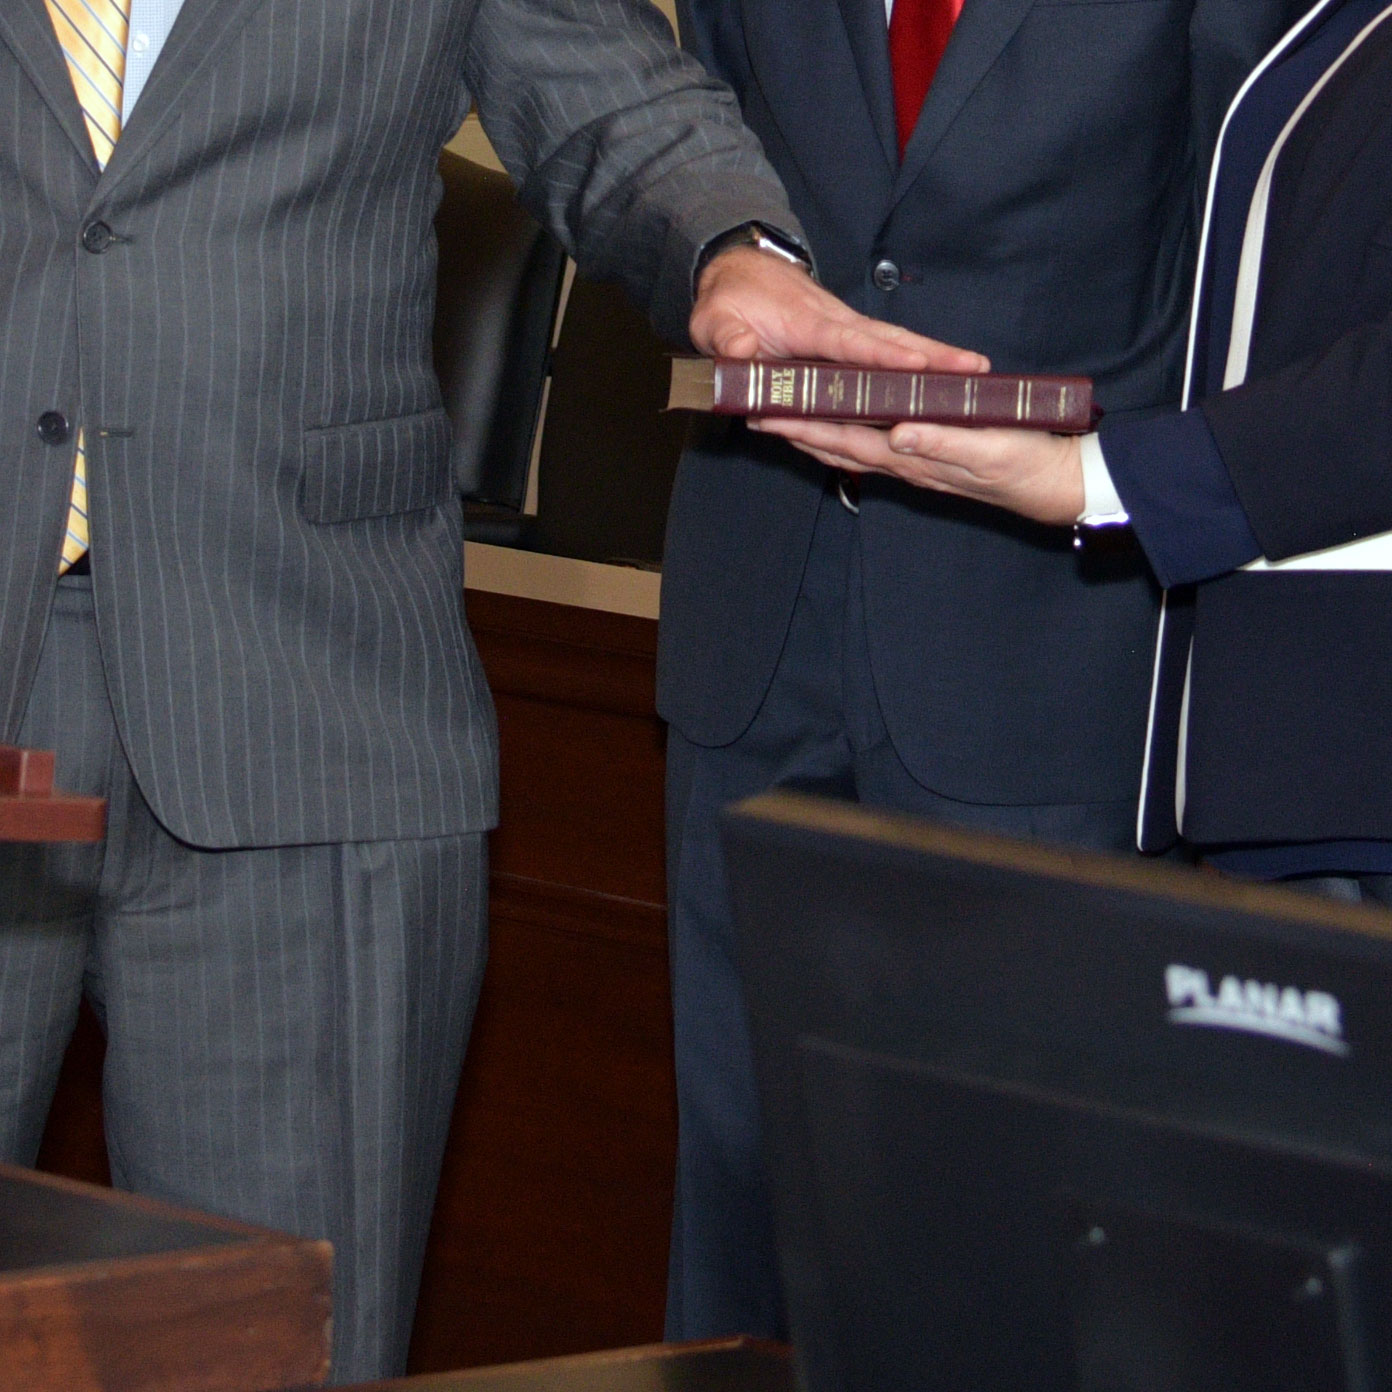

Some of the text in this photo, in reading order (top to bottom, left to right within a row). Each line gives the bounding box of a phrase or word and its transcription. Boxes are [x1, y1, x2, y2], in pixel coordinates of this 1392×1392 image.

[771, 369, 783, 404] HOLY
[783, 368, 795, 406] BIBLE
[1165, 964, 1342, 1036] PLANAR
